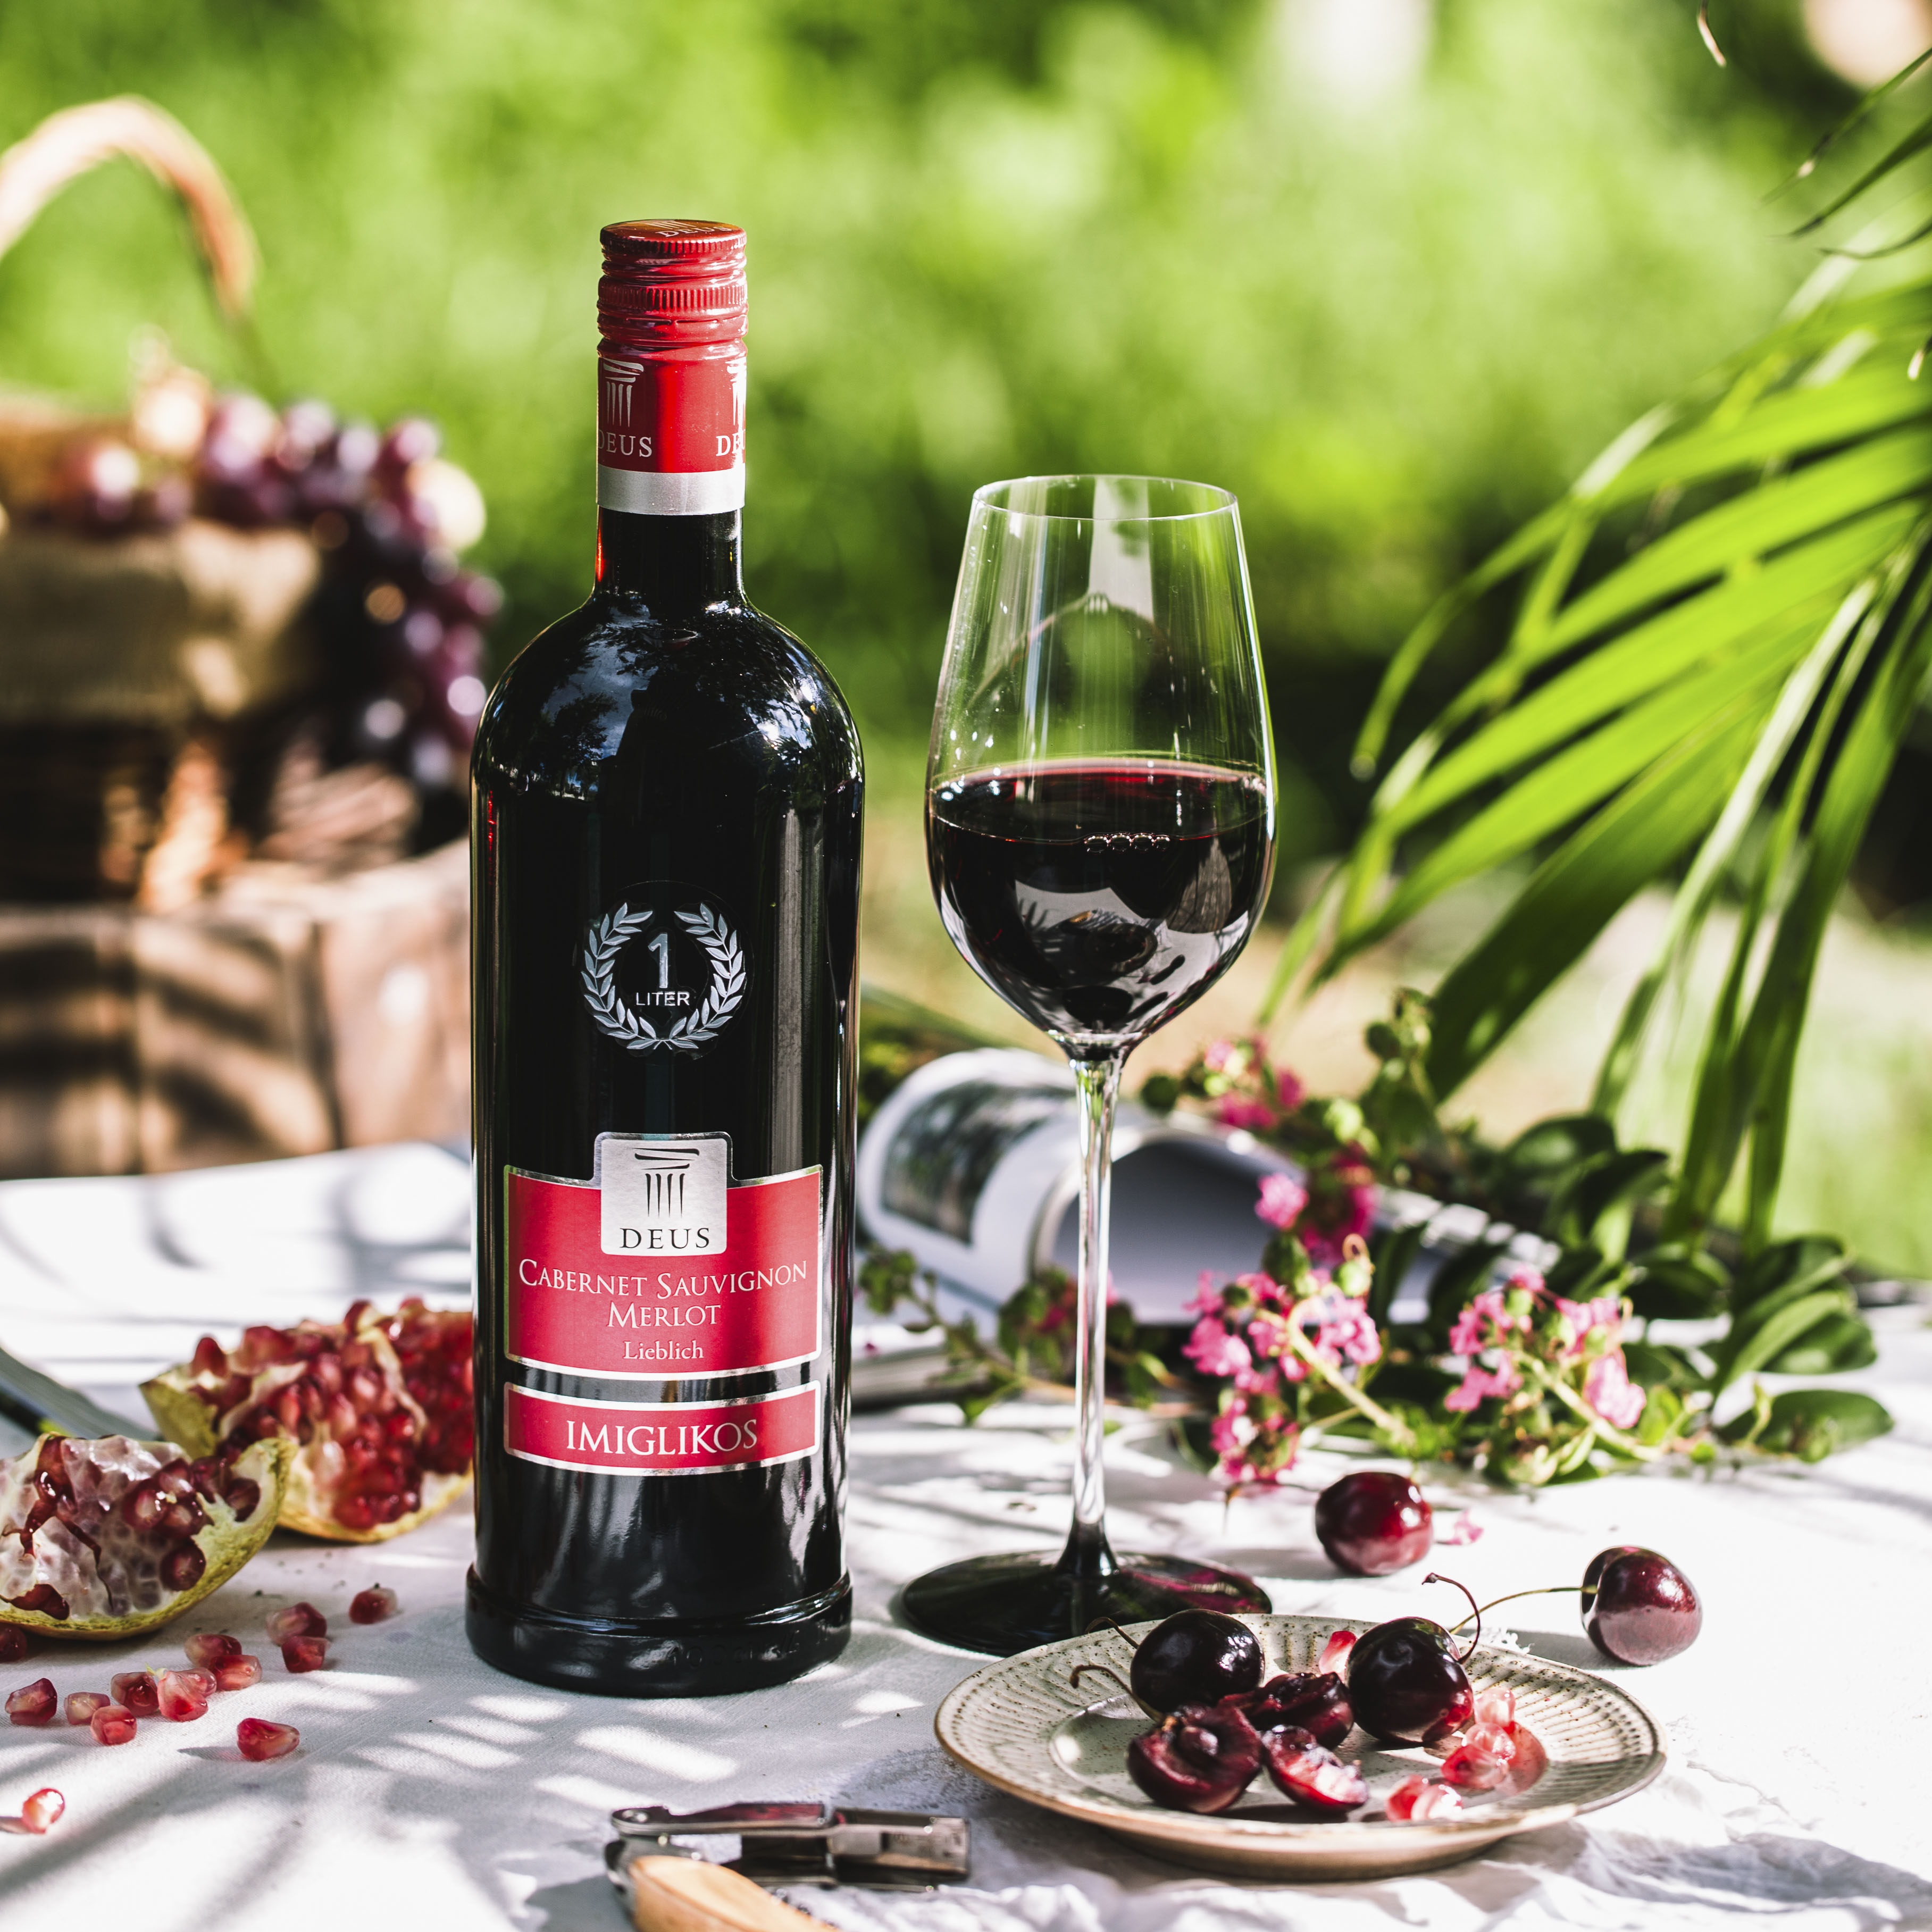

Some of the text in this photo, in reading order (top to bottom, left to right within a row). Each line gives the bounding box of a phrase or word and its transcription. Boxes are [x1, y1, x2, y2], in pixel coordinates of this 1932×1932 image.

[655, 226, 732, 237] DEUS
[648, 933, 668, 988] 1
[636, 992, 690, 1006] LITER
[619, 1227, 710, 1249] DEUS
[519, 1259, 807, 1299] CABERNET SAUVIGNON
[607, 1302, 721, 1328] MERLOT
[623, 1340, 704, 1360] Lieblich
[566, 1419, 757, 1456] IMIGLIKOS
